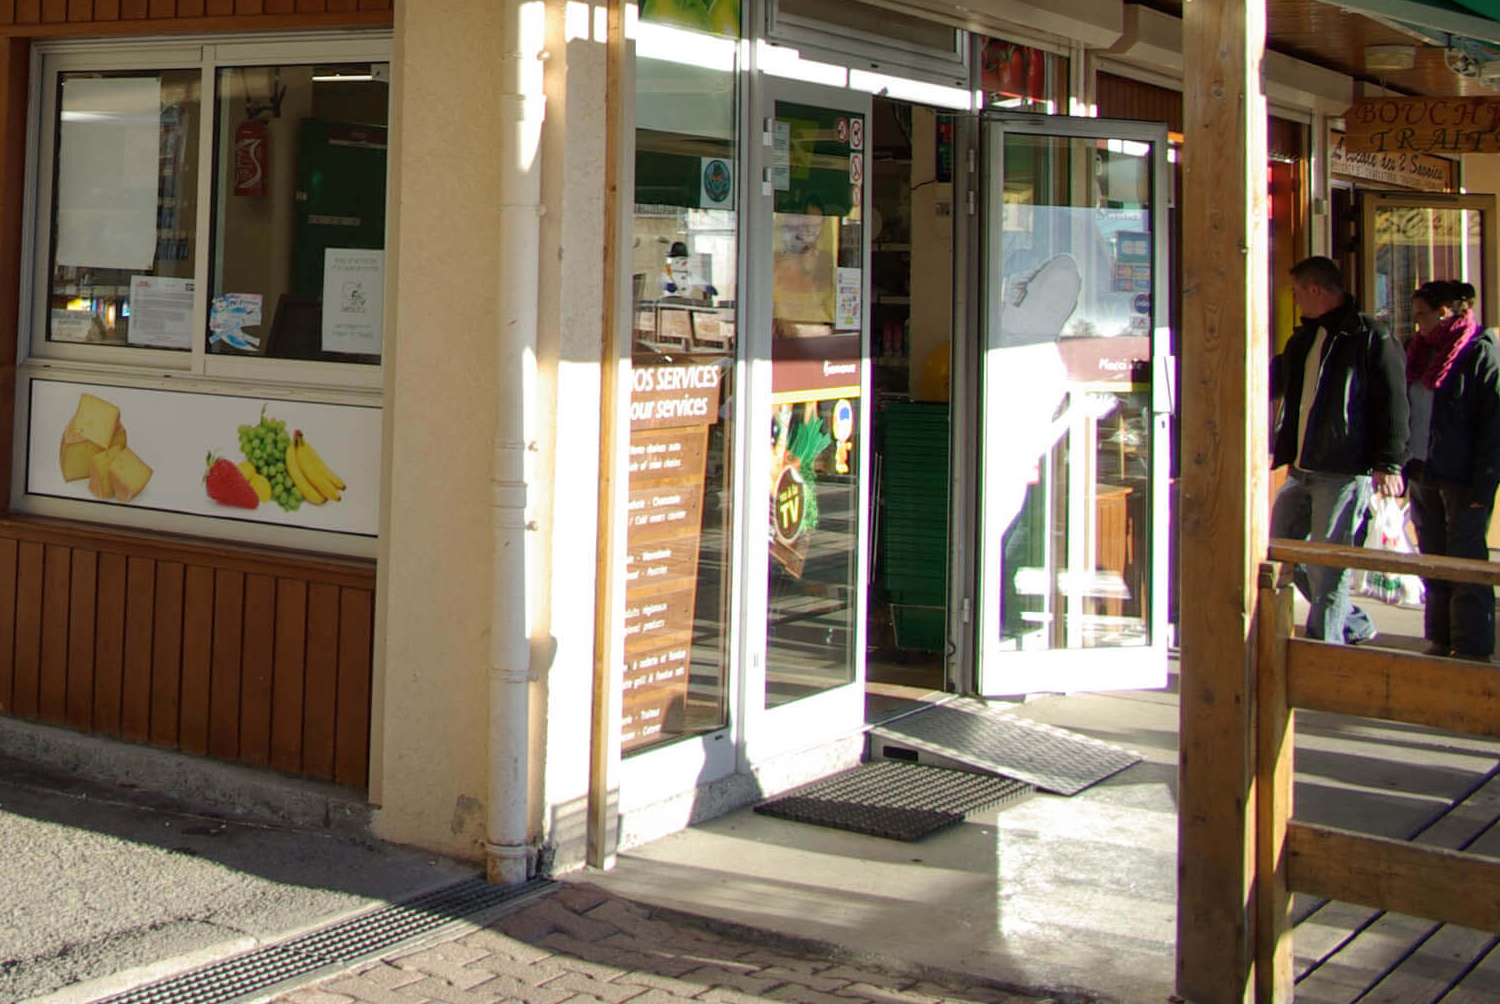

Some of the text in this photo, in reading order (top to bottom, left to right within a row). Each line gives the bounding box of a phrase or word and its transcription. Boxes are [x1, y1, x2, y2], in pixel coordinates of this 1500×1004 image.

[1369, 127, 1500, 153] TRAIT
[656, 365, 719, 391] SERVICES
[655, 395, 708, 419] services
[779, 496, 799, 529] TV
